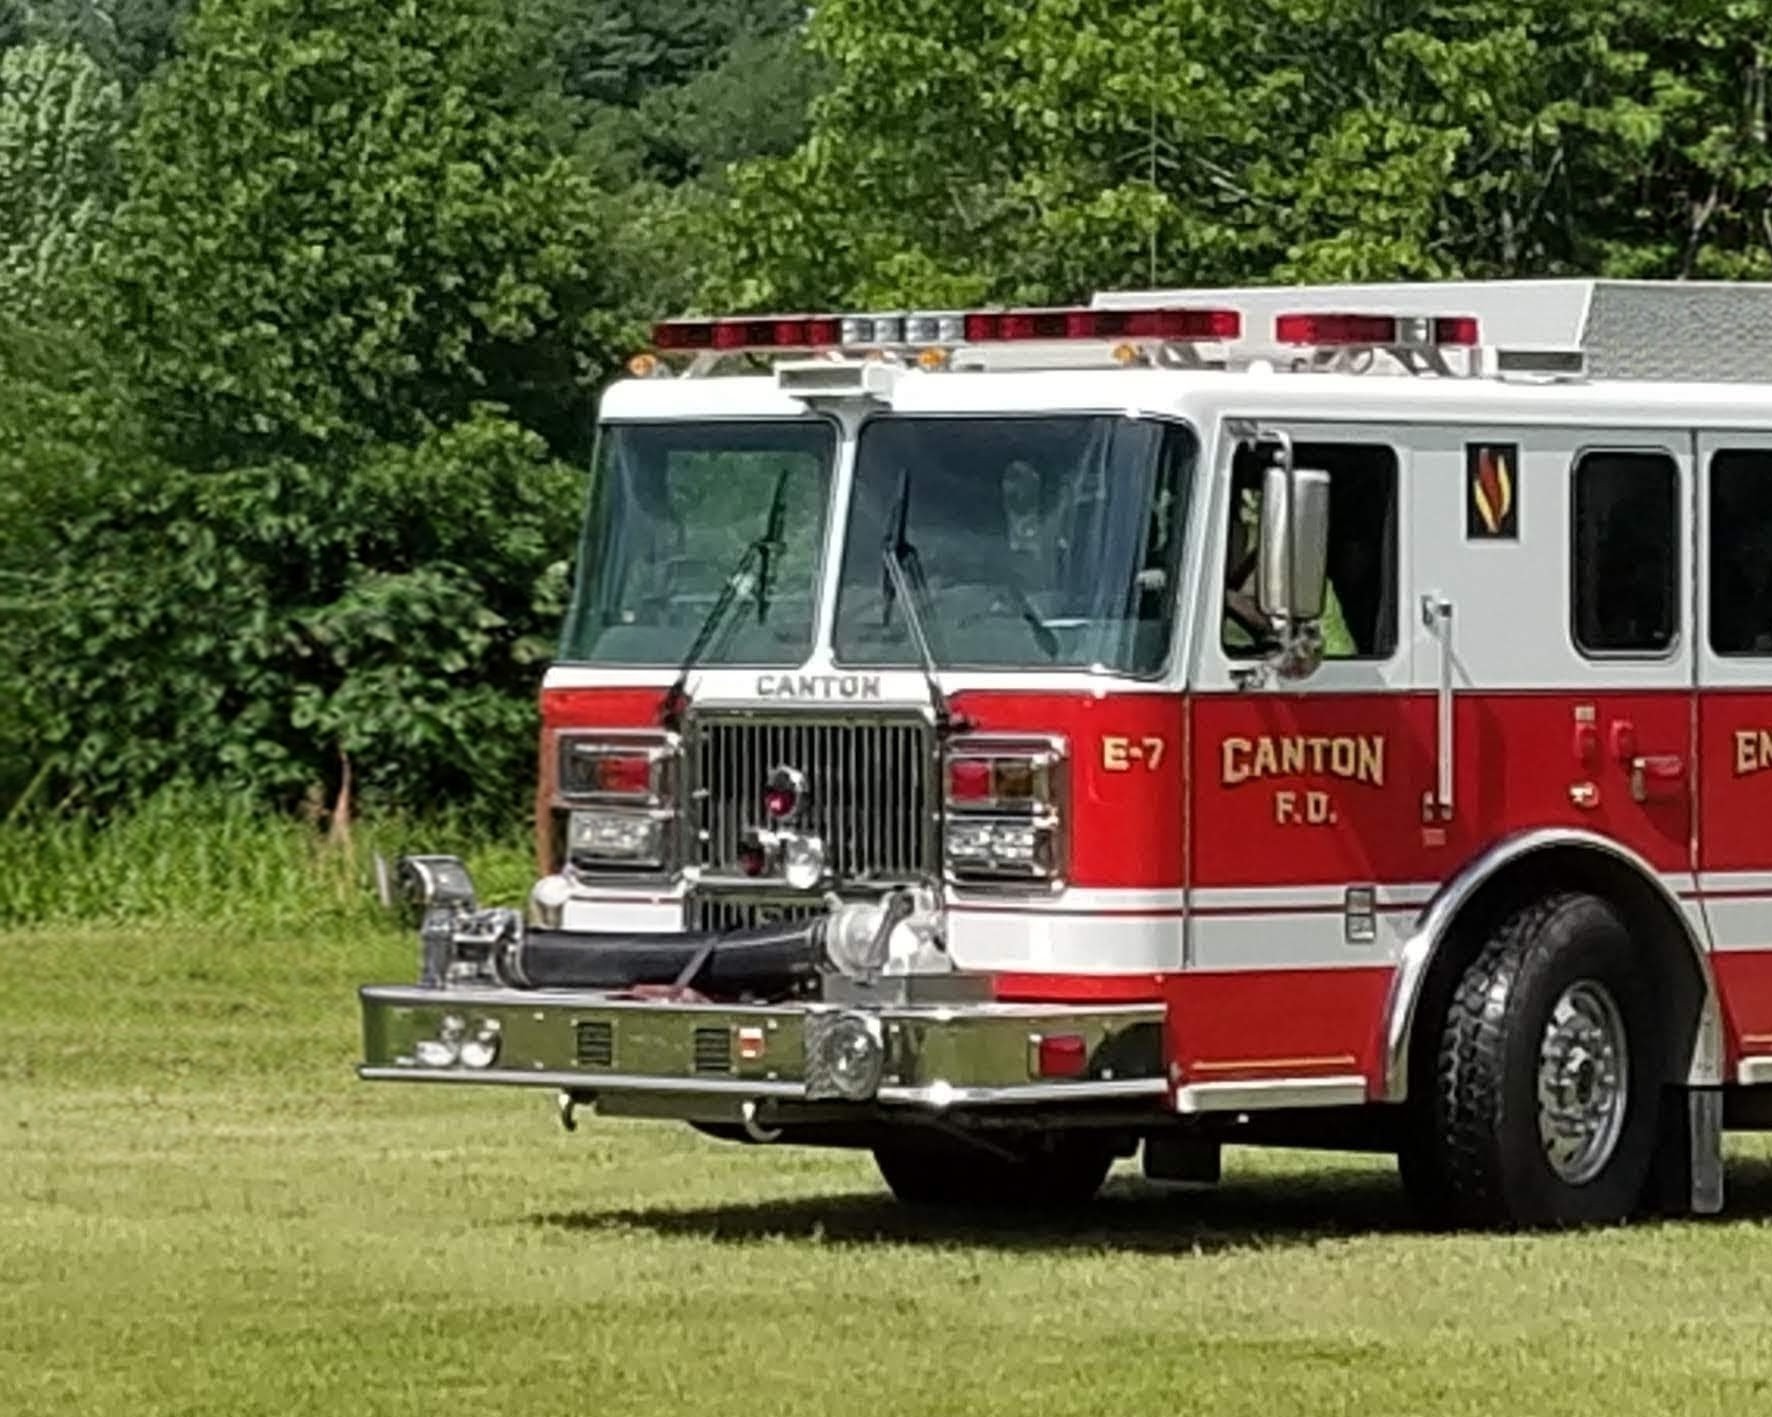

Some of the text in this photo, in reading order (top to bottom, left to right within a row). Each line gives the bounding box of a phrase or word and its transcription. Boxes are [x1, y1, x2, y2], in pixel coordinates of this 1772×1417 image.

[757, 675, 880, 698] CANTON
[1102, 735, 1165, 771] E-7
[1222, 736, 1384, 786] CANTON
[1276, 791, 1338, 824] F.D.
